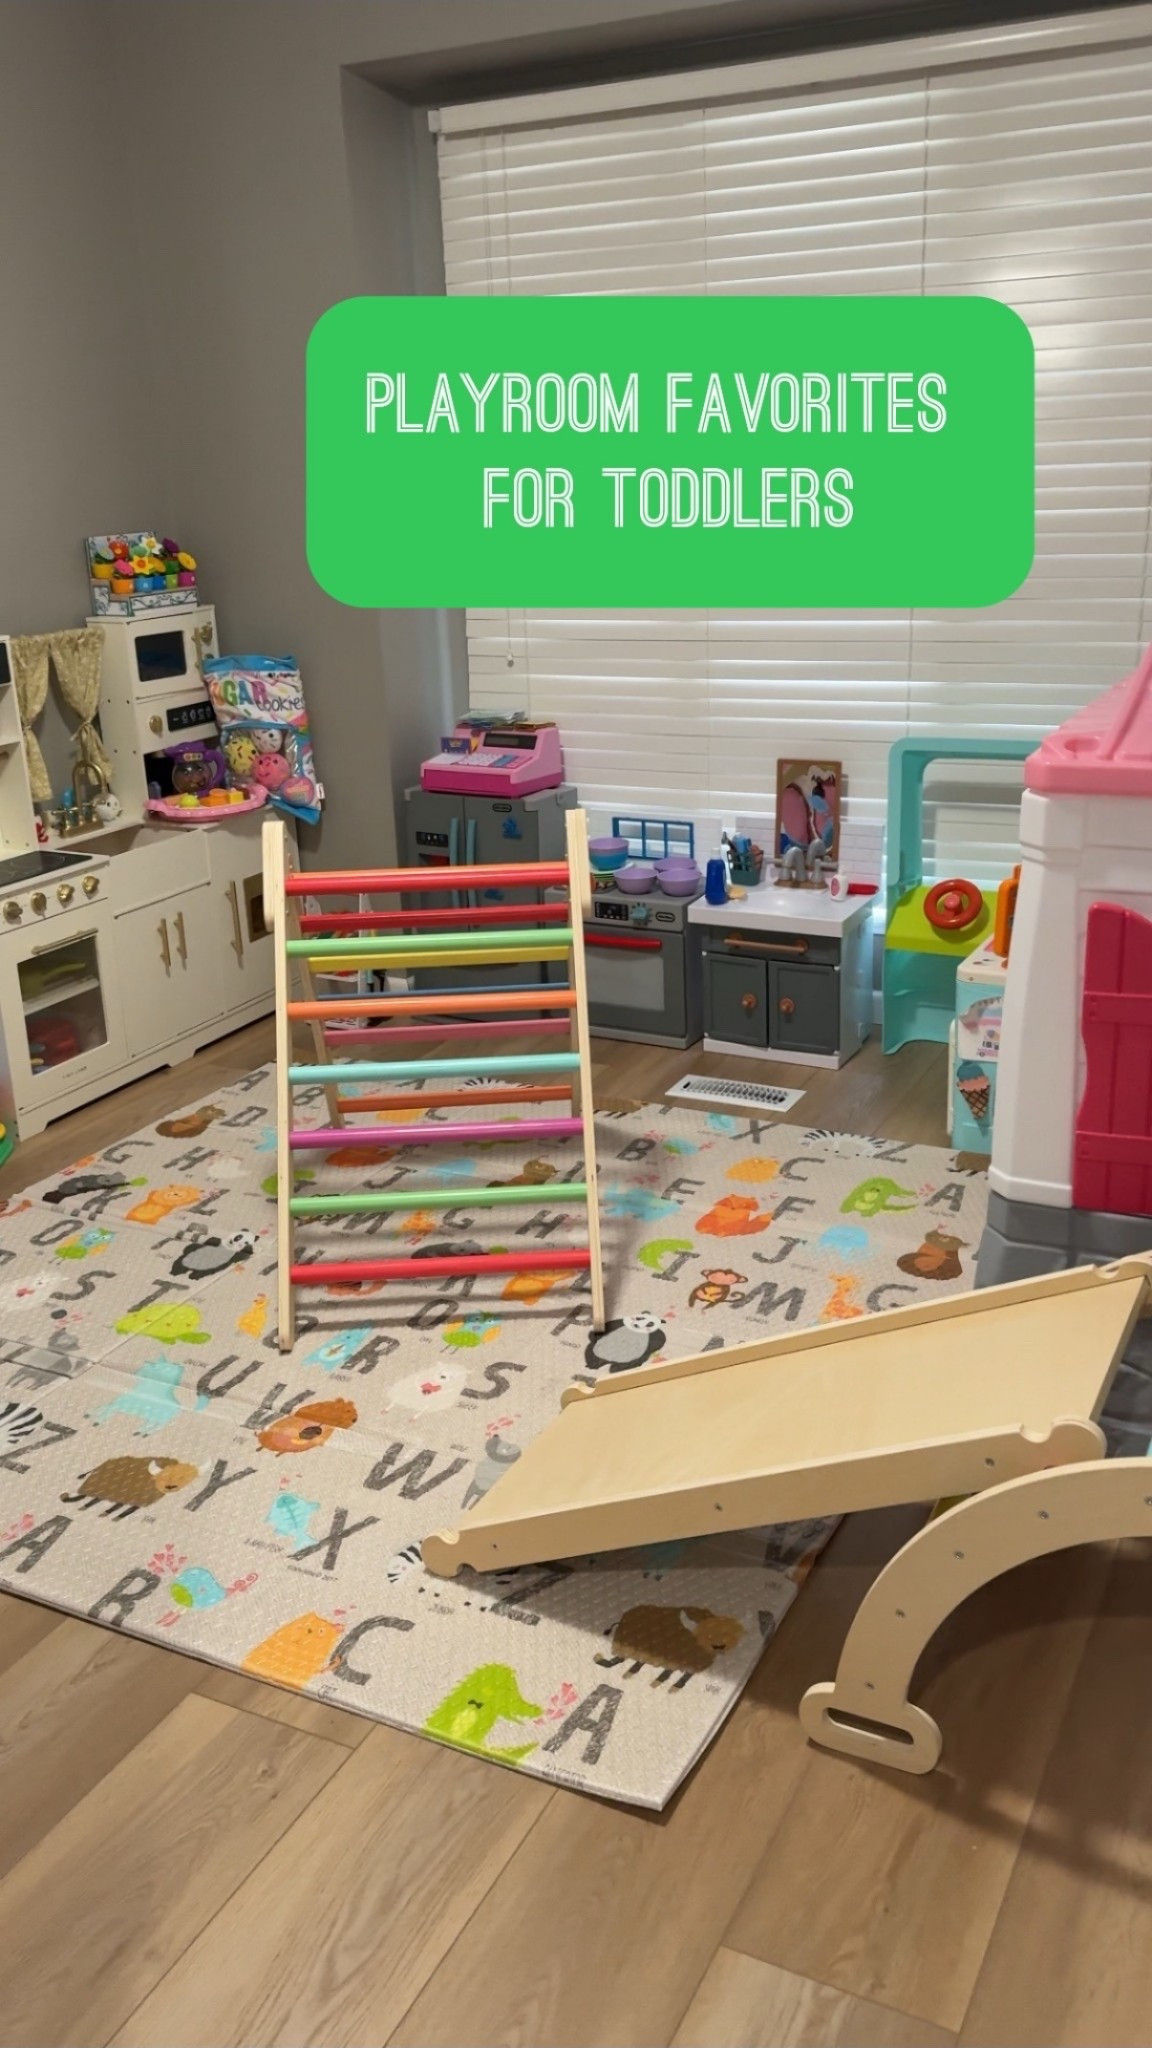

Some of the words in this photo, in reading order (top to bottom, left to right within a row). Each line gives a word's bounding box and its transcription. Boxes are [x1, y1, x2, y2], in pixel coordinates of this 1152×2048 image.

[219, 1106, 268, 1127] D
[103, 1140, 155, 1163] G
[162, 1146, 219, 1171] H
[616, 1138, 656, 1161] B
[779, 1157, 826, 1182] C
[771, 1196, 816, 1221] F
[924, 1183, 975, 1212] A
[30, 1219, 85, 1247] O
[514, 1210, 569, 1239] H
[652, 1250, 700, 1282] I
[752, 1236, 807, 1264] J
[50, 1269, 117, 1301] S
[127, 1279, 190, 1313] T
[729, 1281, 807, 1322] M
[406, 1298, 459, 1331] O
[340, 1335, 400, 1374] R
[197, 1354, 265, 1398] U
[460, 1361, 528, 1400] S
[0, 1421, 78, 1475] Z
[183, 1459, 258, 1512] Y
[363, 1442, 470, 1501] W
[0, 1514, 74, 1574] A
[287, 1506, 381, 1571] X
[87, 1567, 161, 1628] R
[329, 1614, 415, 1686] C
[541, 1683, 624, 1766] A
